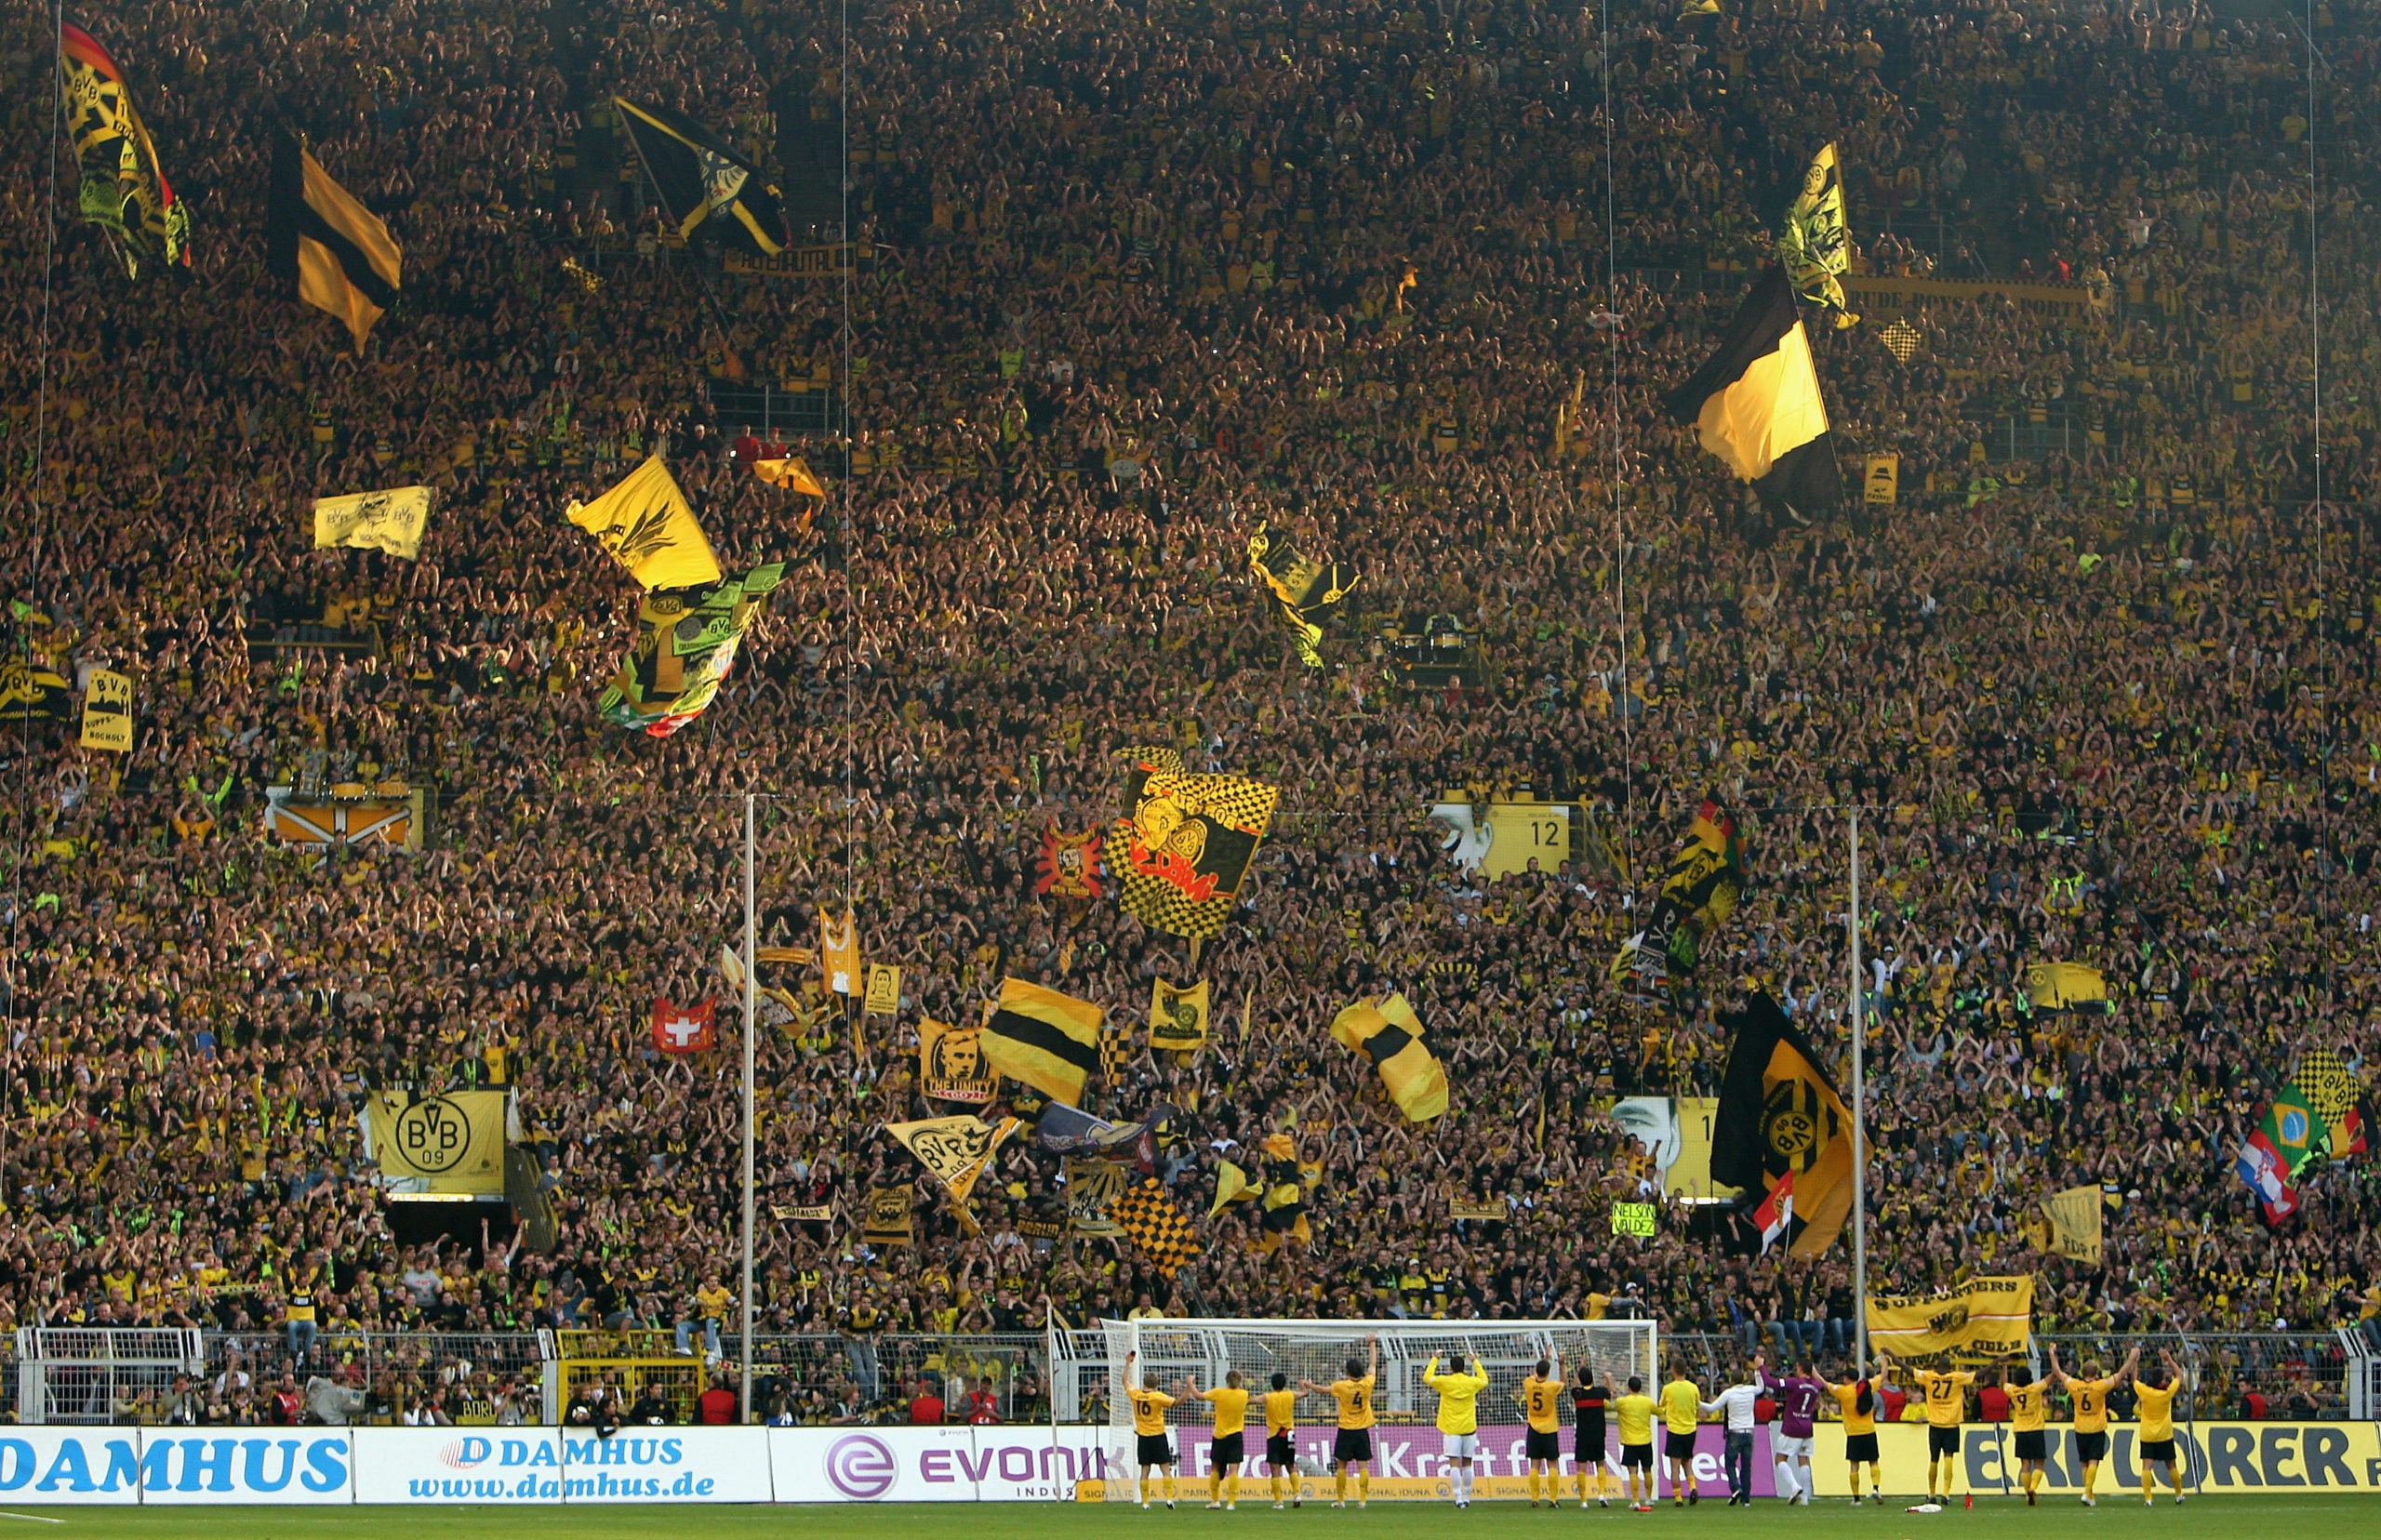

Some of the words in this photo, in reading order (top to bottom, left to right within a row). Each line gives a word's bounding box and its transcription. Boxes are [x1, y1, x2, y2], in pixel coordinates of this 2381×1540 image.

[74, 74, 98, 100] BVB
[711, 619, 731, 633] BVB
[89, 731, 126, 743] BOCHOLT
[1531, 821, 1559, 846] 12
[928, 1080, 951, 1092] THE
[2323, 1074, 2347, 1104] BVB
[407, 1106, 459, 1149] BVB
[1776, 1116, 1811, 1151] BVB
[421, 1149, 445, 1164] 09
[1614, 1203, 1656, 1218] NELSON
[1614, 1219, 1654, 1234] VALDEZ
[1972, 1339, 2022, 1352] GELB
[1932, 1379, 1952, 1399] 27
[1137, 1400, 1151, 1415] 16
[1352, 1391, 1363, 1410] 4
[1533, 1391, 1543, 1411] 5
[1801, 1393, 1810, 1413] 1
[2017, 1394, 2028, 1412] 9
[2082, 1393, 2092, 1412] 6
[499, 1439, 683, 1467] DAMHUS
[1380, 1440, 1496, 1478] Krat
[0, 1438, 348, 1493] DAMHUS
[408, 1471, 714, 1498] www.damhus.de
[1399, 1488, 1430, 1497] IDUNA
[1591, 1487, 1618, 1495] PRK
